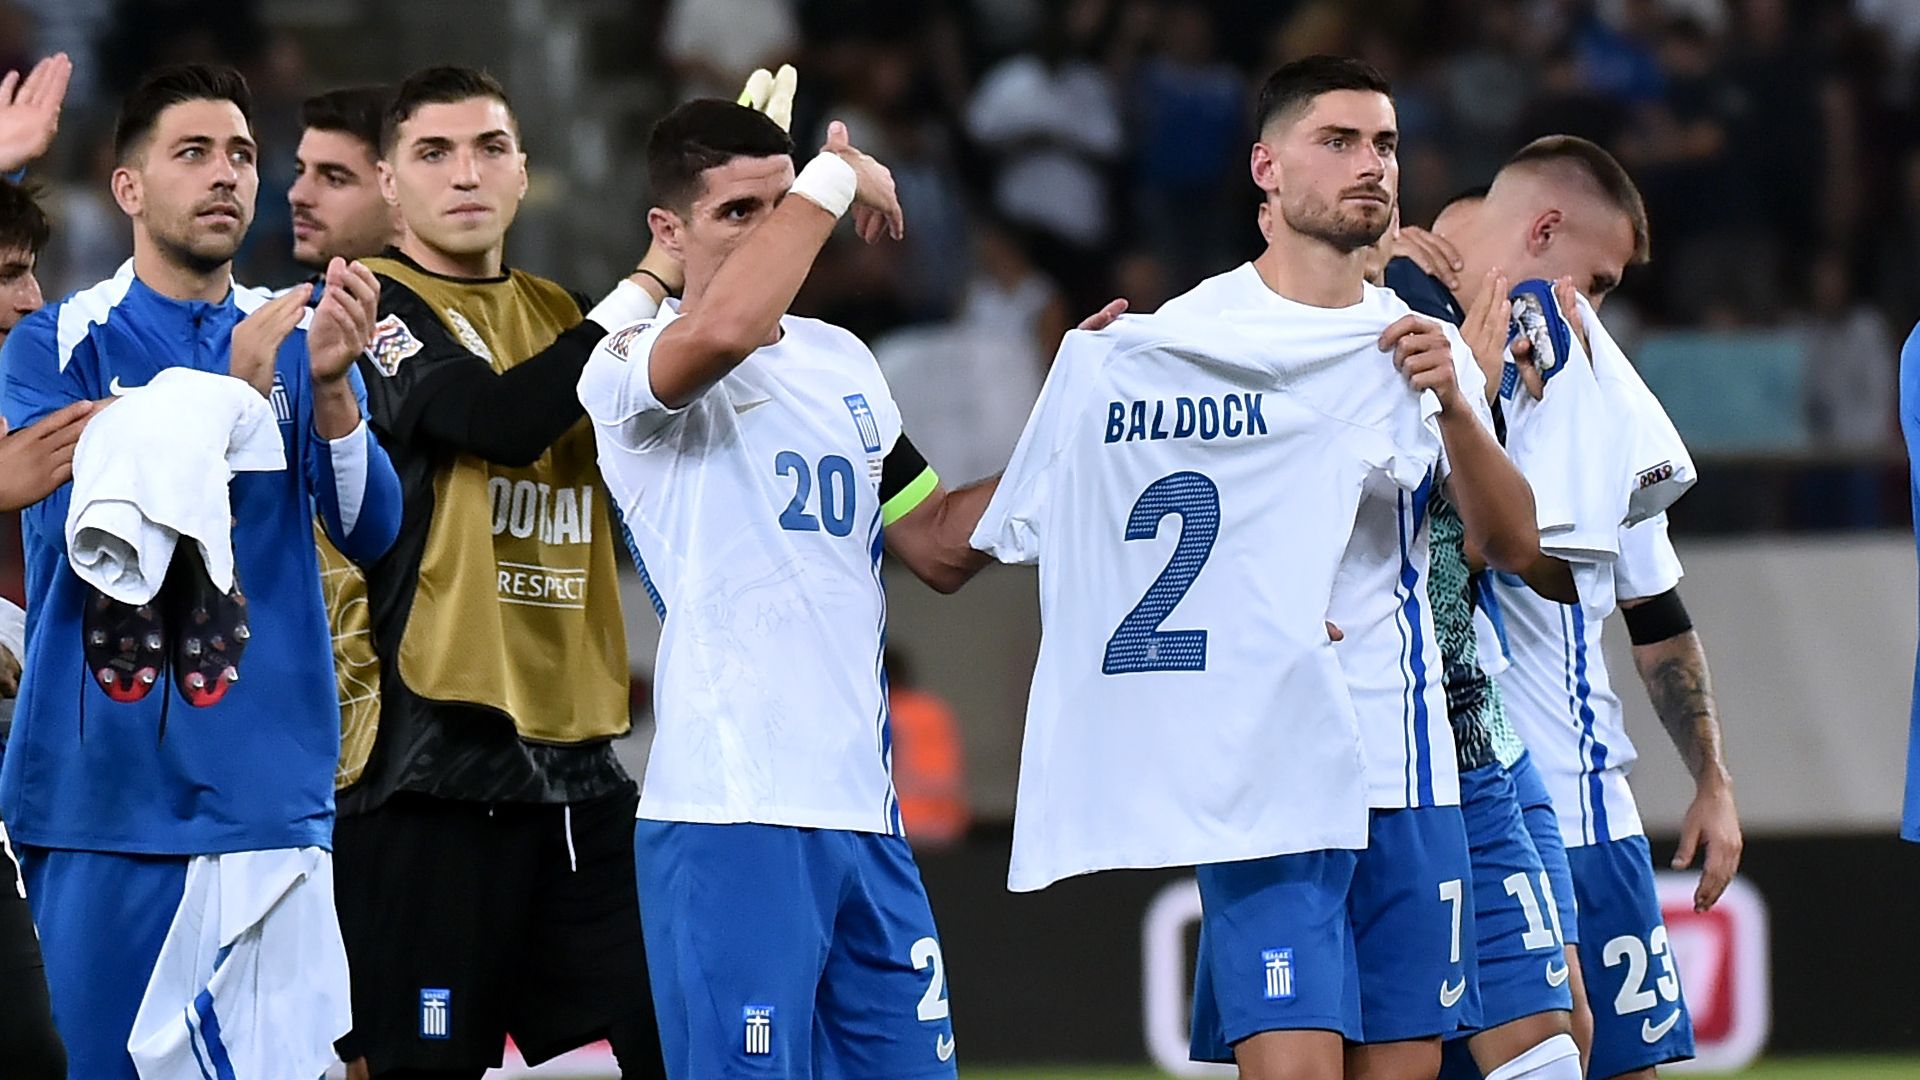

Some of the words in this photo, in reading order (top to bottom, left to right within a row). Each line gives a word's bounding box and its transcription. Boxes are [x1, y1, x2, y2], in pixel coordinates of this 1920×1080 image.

[1104, 393, 1268, 443] BALDOCK
[775, 450, 857, 538] 20
[497, 571, 585, 600] RESPECT
[1101, 470, 1221, 675] 2
[1438, 878, 1462, 964] 7
[1602, 925, 1680, 1016] 23
